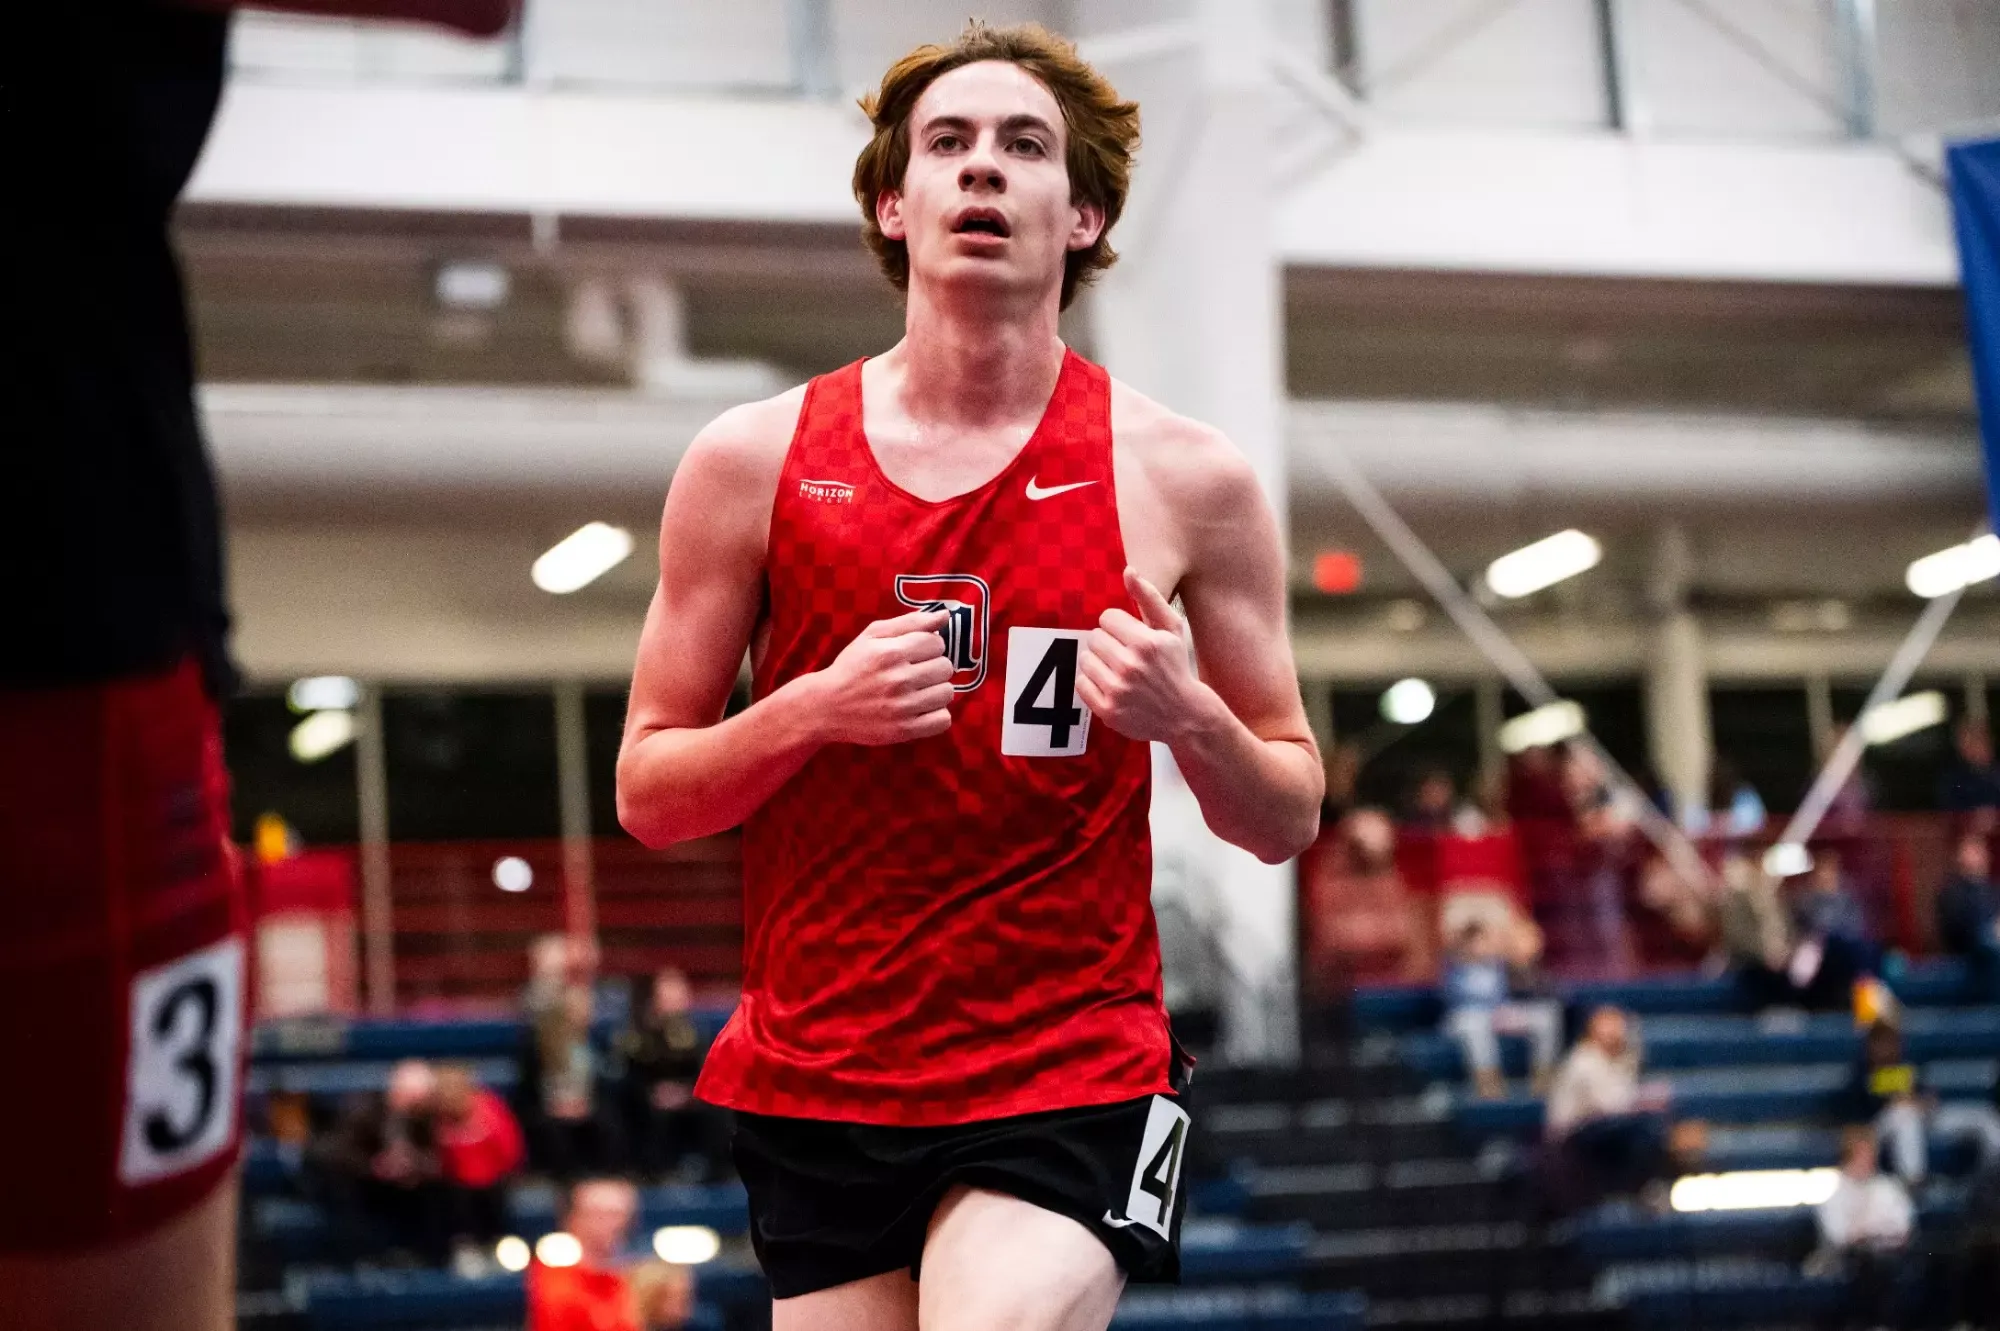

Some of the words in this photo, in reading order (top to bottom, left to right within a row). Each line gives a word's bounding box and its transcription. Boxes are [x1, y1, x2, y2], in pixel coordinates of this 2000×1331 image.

[800, 482, 853, 497] HORIZON
[1013, 638, 1081, 748] 4
[145, 977, 217, 1153] 3
[1140, 1116, 1185, 1227] 4
